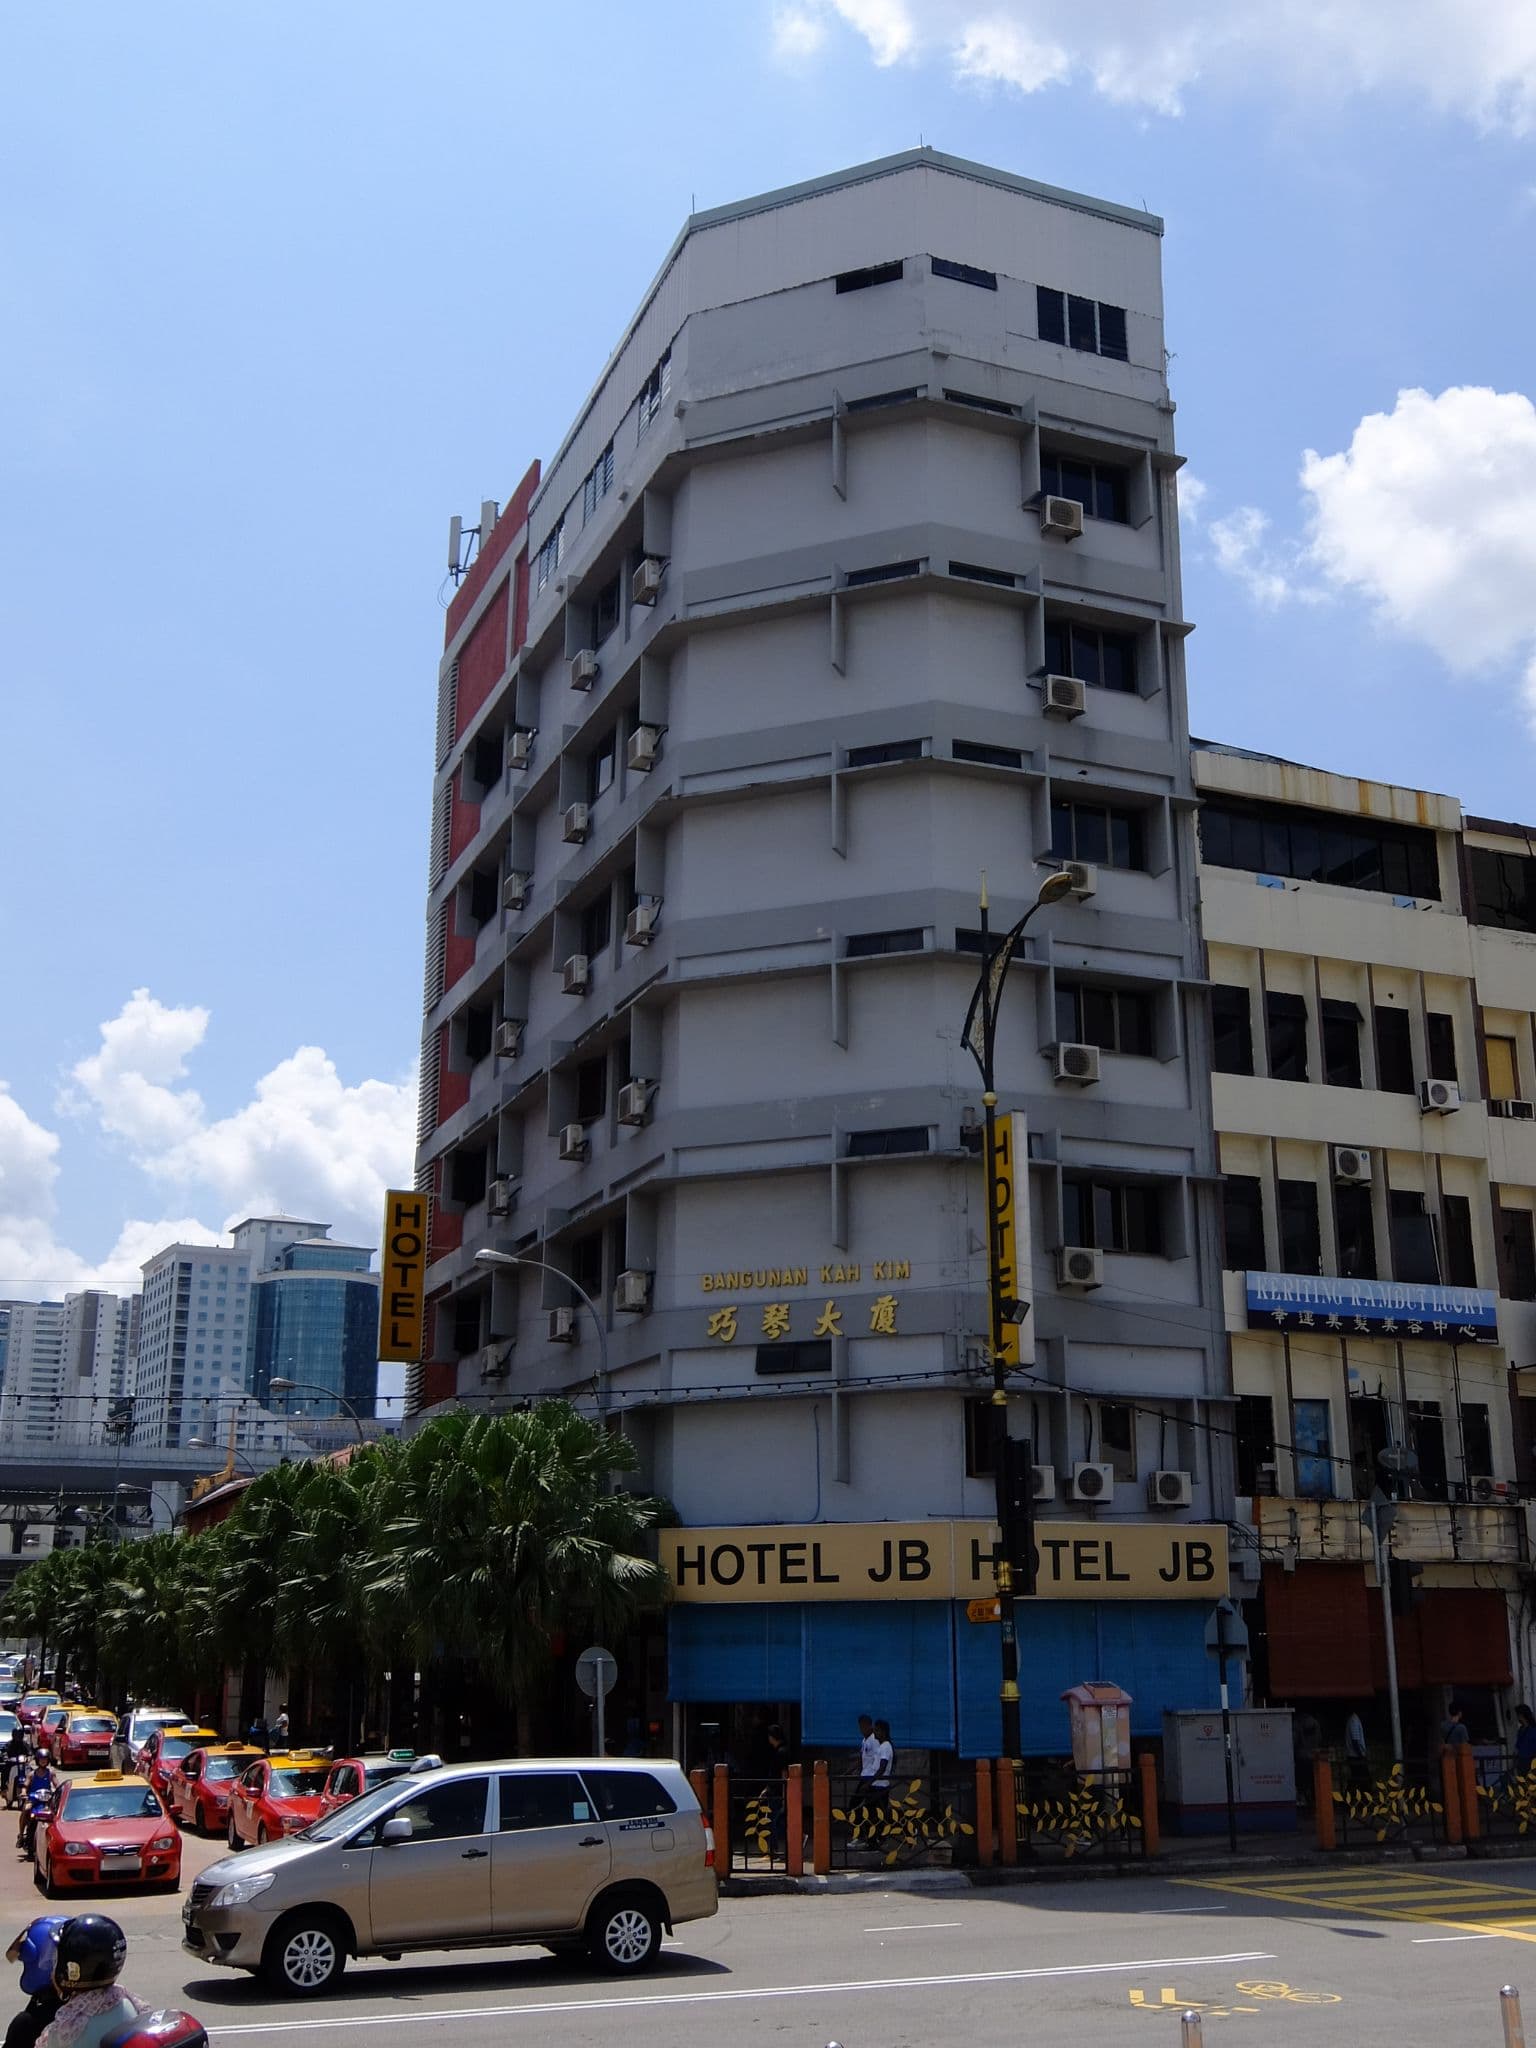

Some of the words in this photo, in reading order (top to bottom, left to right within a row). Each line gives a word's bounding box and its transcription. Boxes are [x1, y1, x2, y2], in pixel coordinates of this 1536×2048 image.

[988, 1130, 1013, 1351] HOTE
[391, 1203, 421, 1347] HOTEL
[703, 1266, 808, 1292] BANGUNAN
[820, 1264, 861, 1283] KAH
[873, 1259, 911, 1280] KIM
[1256, 1276, 1343, 1305] KERITING
[1351, 1281, 1427, 1312] RAMBUT
[1431, 1288, 1485, 1315] LUCKY
[676, 1543, 839, 1586] HOTEL
[868, 1540, 931, 1582] JB
[1159, 1541, 1215, 1582] JB
